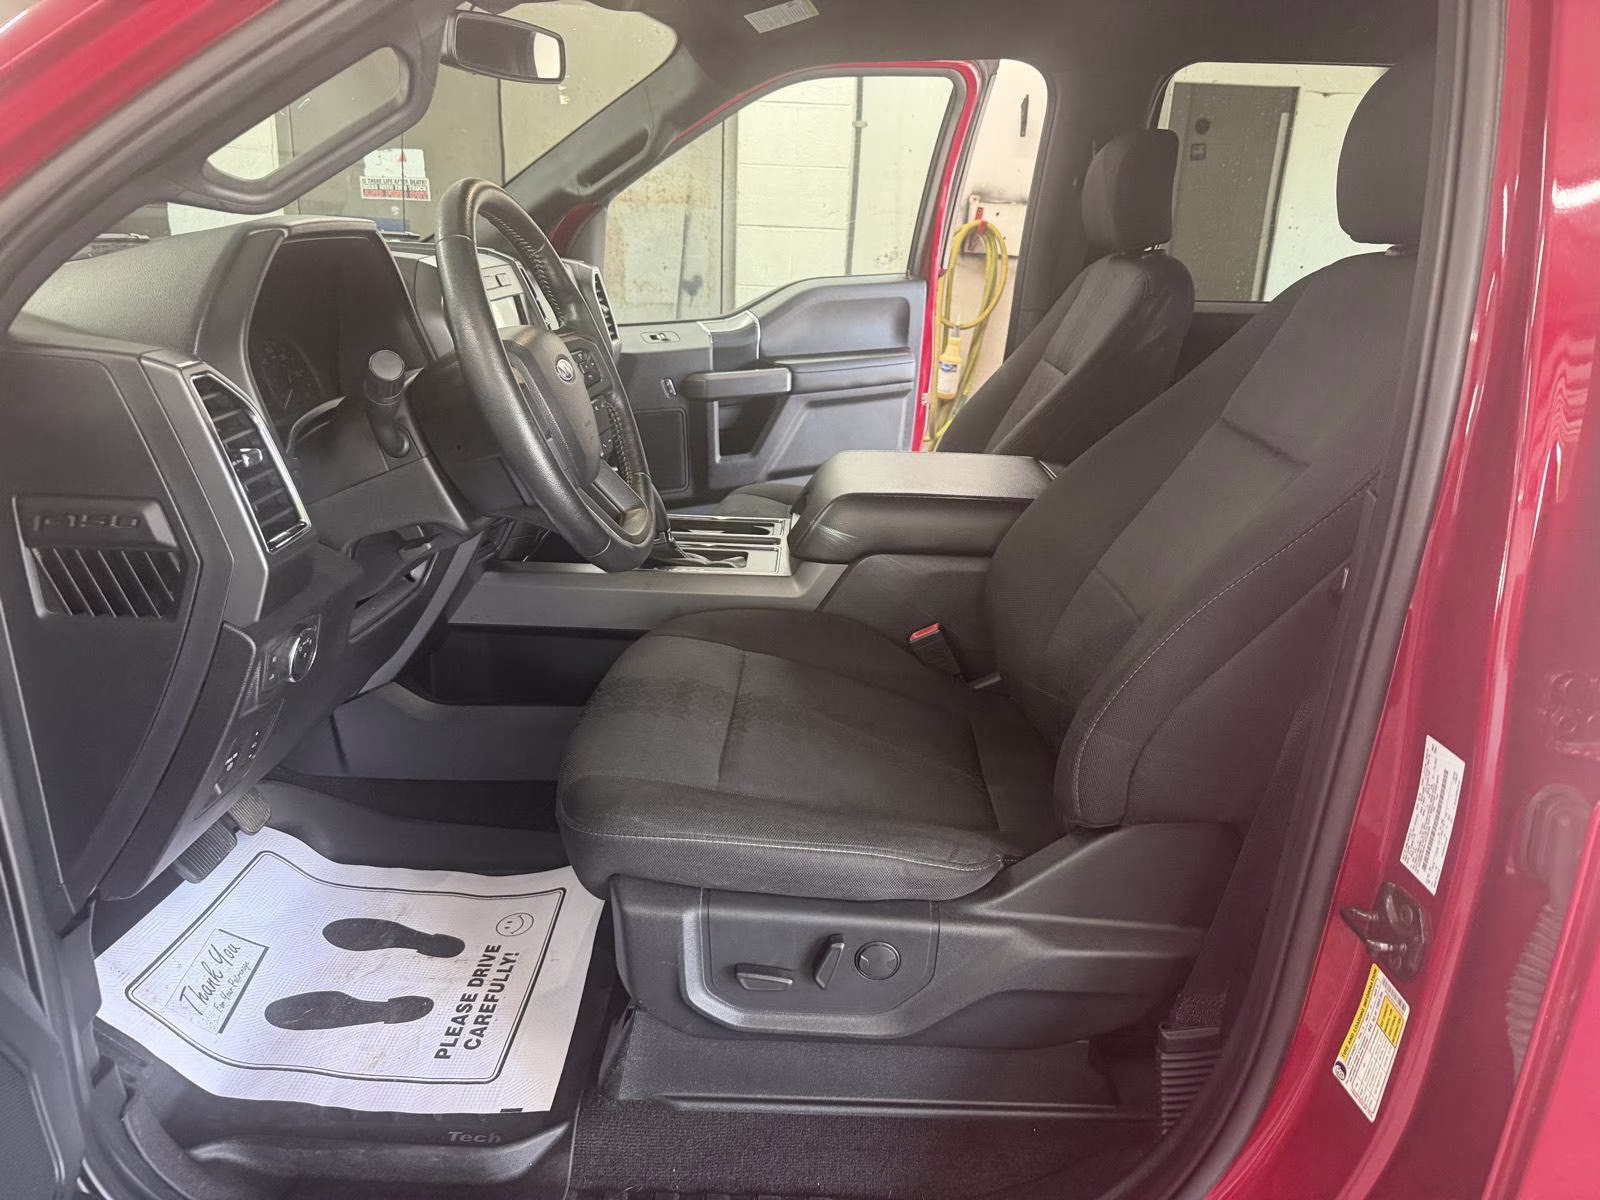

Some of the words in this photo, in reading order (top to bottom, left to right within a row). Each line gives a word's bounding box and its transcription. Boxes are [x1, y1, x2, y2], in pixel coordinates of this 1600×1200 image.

[179, 961, 224, 1016] Thank
[208, 943, 241, 967] You
[219, 986, 235, 1001] Your
[433, 992, 479, 1060] PLEASE
[466, 944, 502, 988] DRIVE
[463, 952, 520, 1051] CAREFULLY!
[1341, 1045, 1350, 1058] TIRE
[1347, 1032, 1355, 1046] AND
[1353, 1007, 1366, 1034] LOADING
[1363, 967, 1378, 1008] INFORMATION
[447, 1130, 502, 1144] Tech
